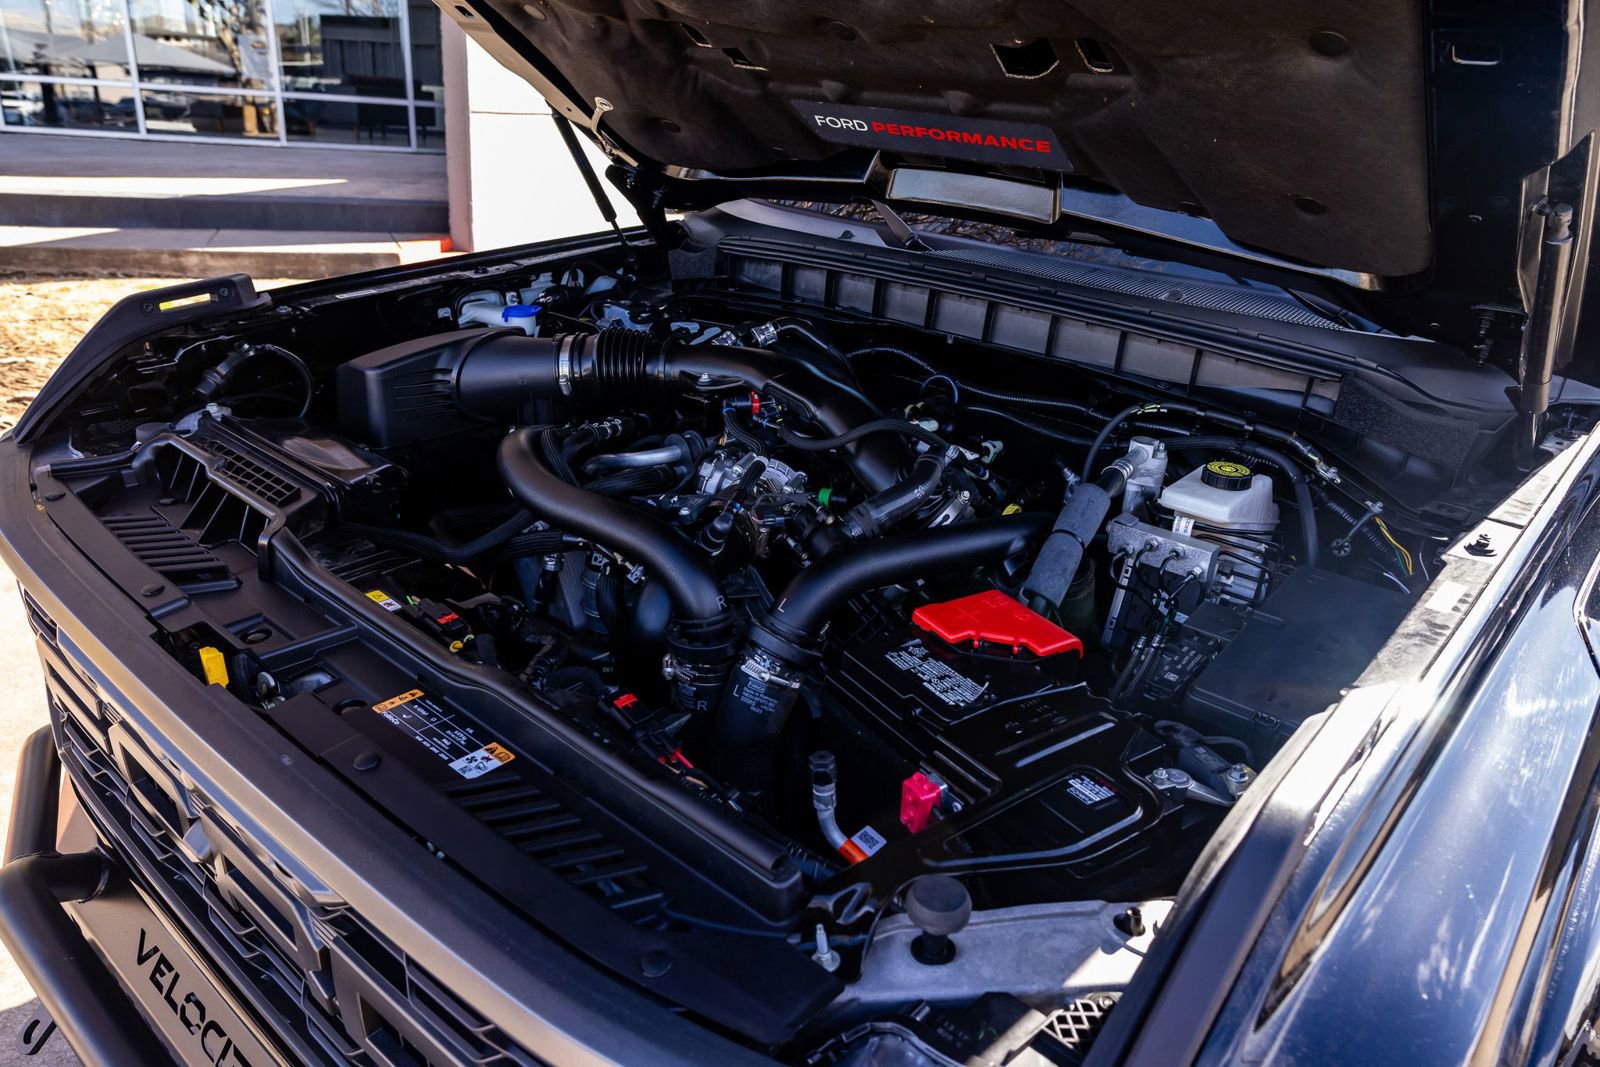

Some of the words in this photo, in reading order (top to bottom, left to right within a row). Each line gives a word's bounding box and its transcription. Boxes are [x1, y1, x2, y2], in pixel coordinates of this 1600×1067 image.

[814, 115, 868, 131] FORD
[871, 121, 1051, 153] PERFORMANCE
[716, 595, 727, 610] R
[778, 598, 786, 613] L
[733, 684, 739, 697] L
[697, 700, 708, 711] R
